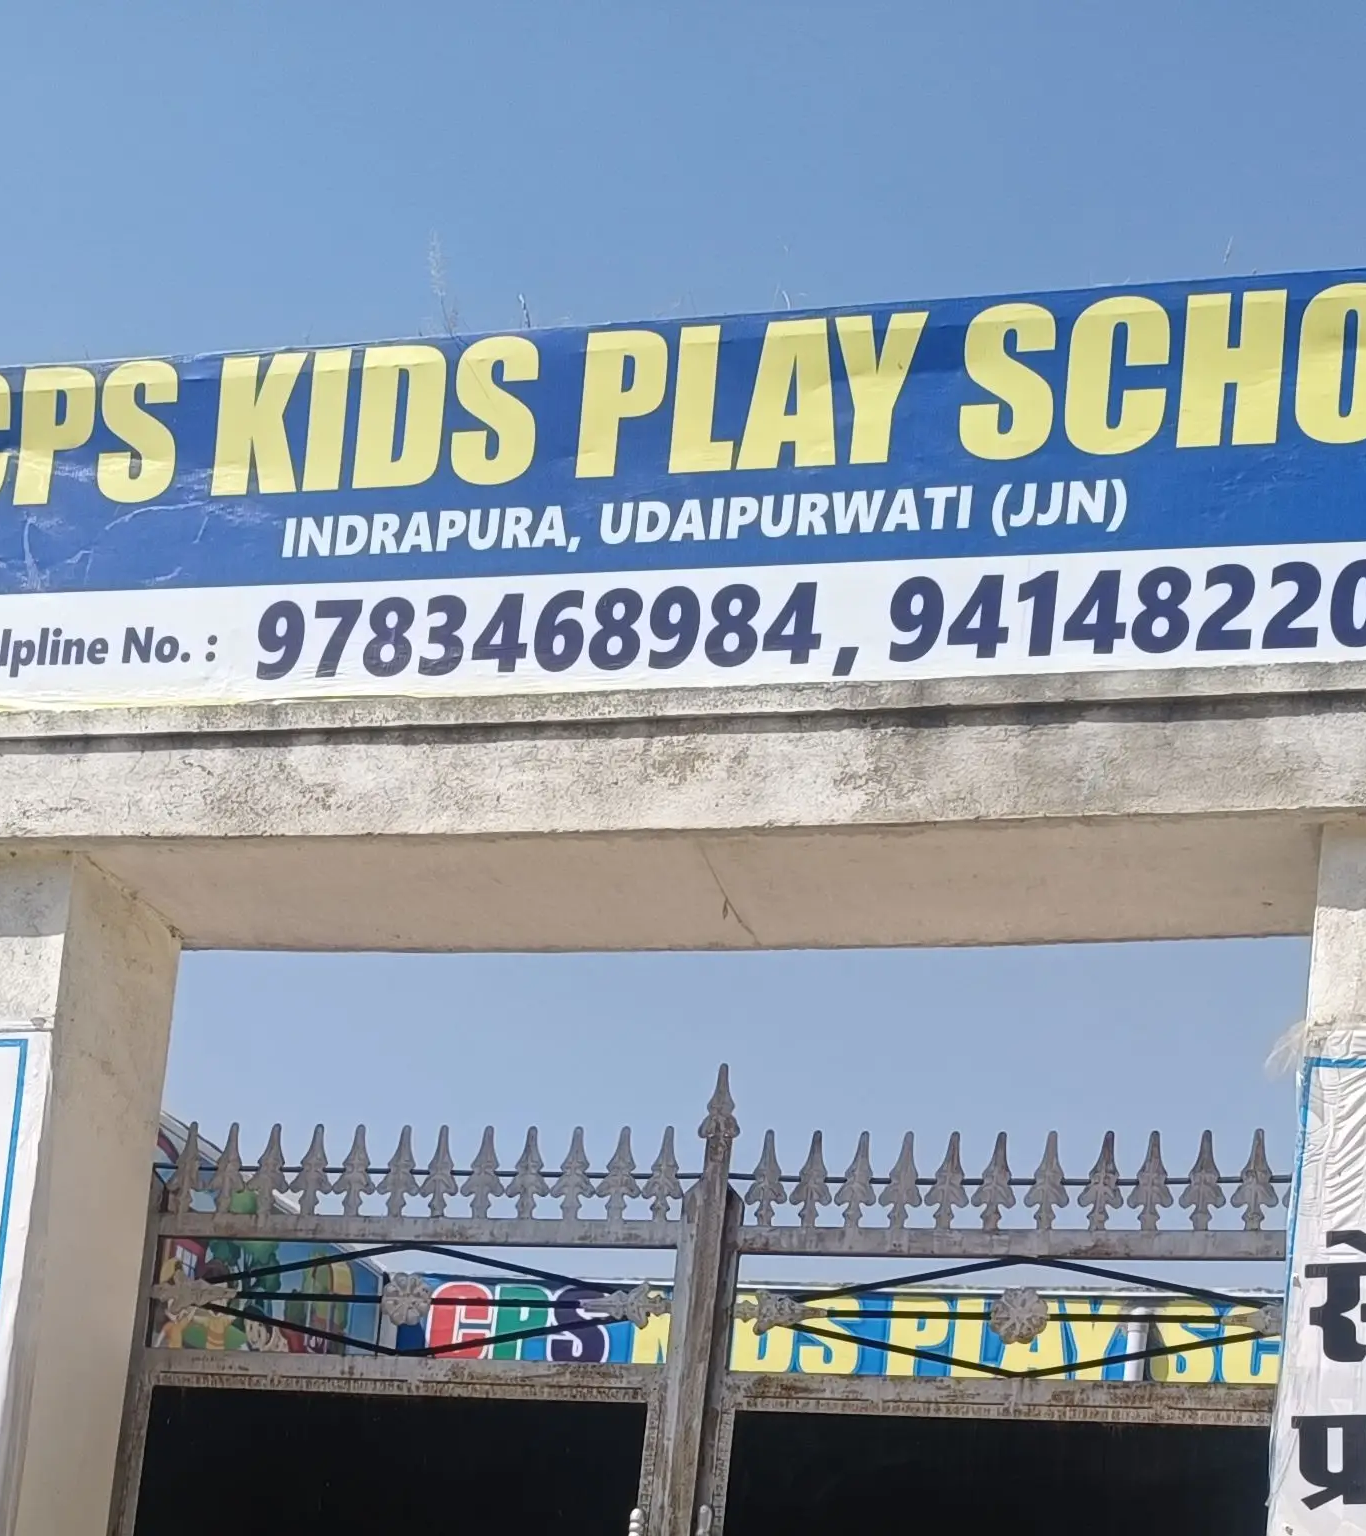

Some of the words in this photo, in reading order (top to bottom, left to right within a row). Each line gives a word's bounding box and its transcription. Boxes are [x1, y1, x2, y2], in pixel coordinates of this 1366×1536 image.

[210, 335, 539, 497] KIDS
[575, 311, 928, 479] PLAY
[281, 506, 581, 560] INDRAPURA,
[598, 486, 972, 545] UDAIPURWATI
[990, 478, 1128, 538] (JJN)
[121, 625, 191, 667] No.
